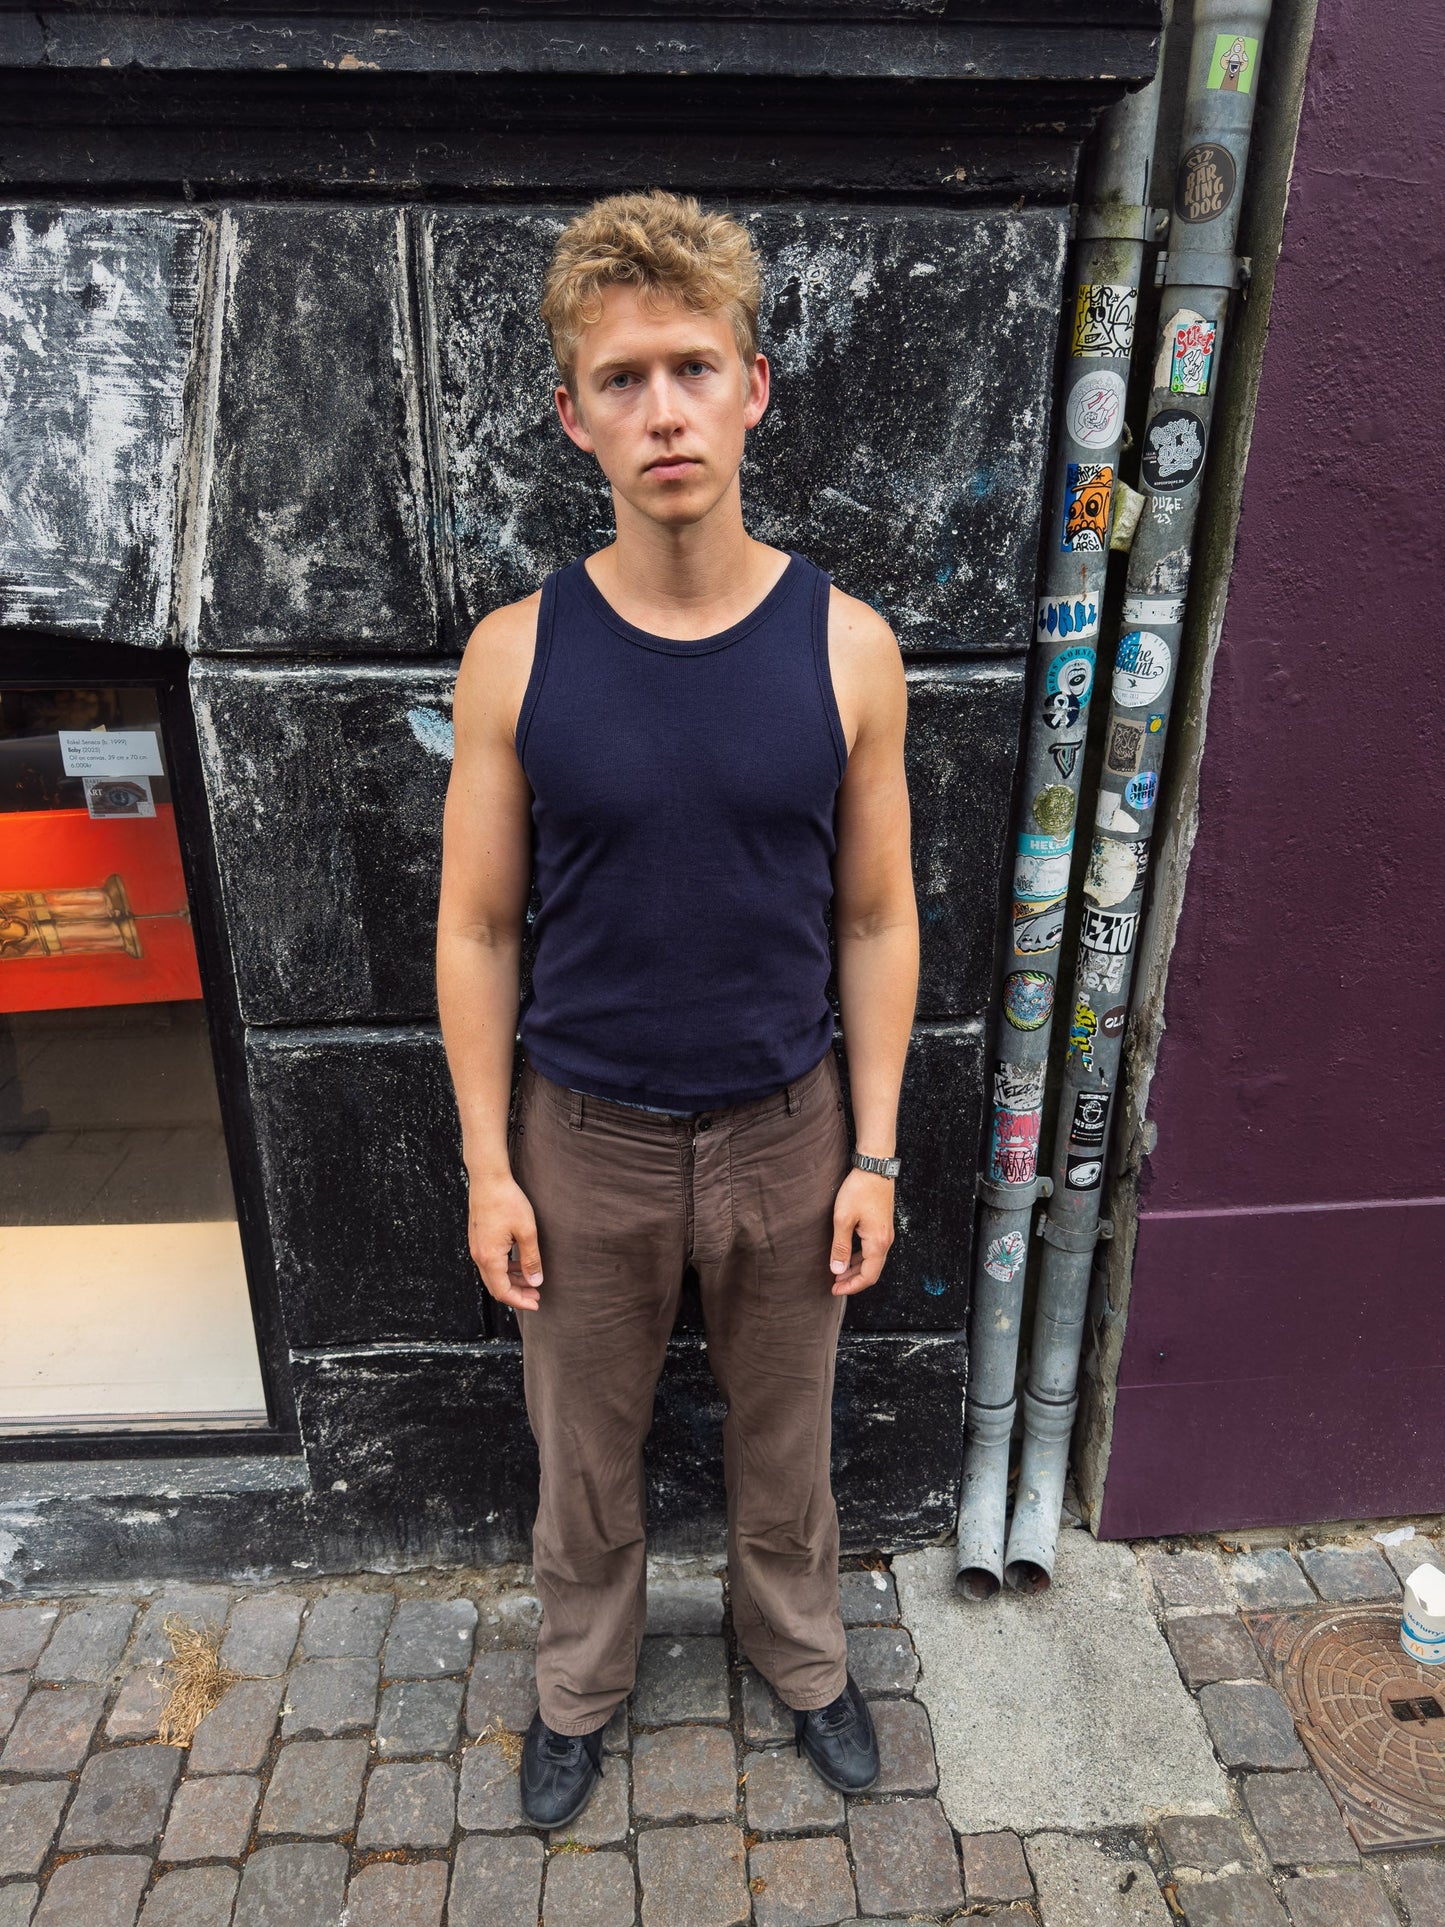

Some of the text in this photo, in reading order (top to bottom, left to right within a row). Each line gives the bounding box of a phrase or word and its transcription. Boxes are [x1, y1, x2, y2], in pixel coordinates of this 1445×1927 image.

[1186, 163, 1217, 190] BAR
[1184, 176, 1224, 206] KING
[1190, 193, 1222, 219] DOG
[1128, 643, 1152, 662] The
[1407, 1612, 1441, 1637] McFlurry
